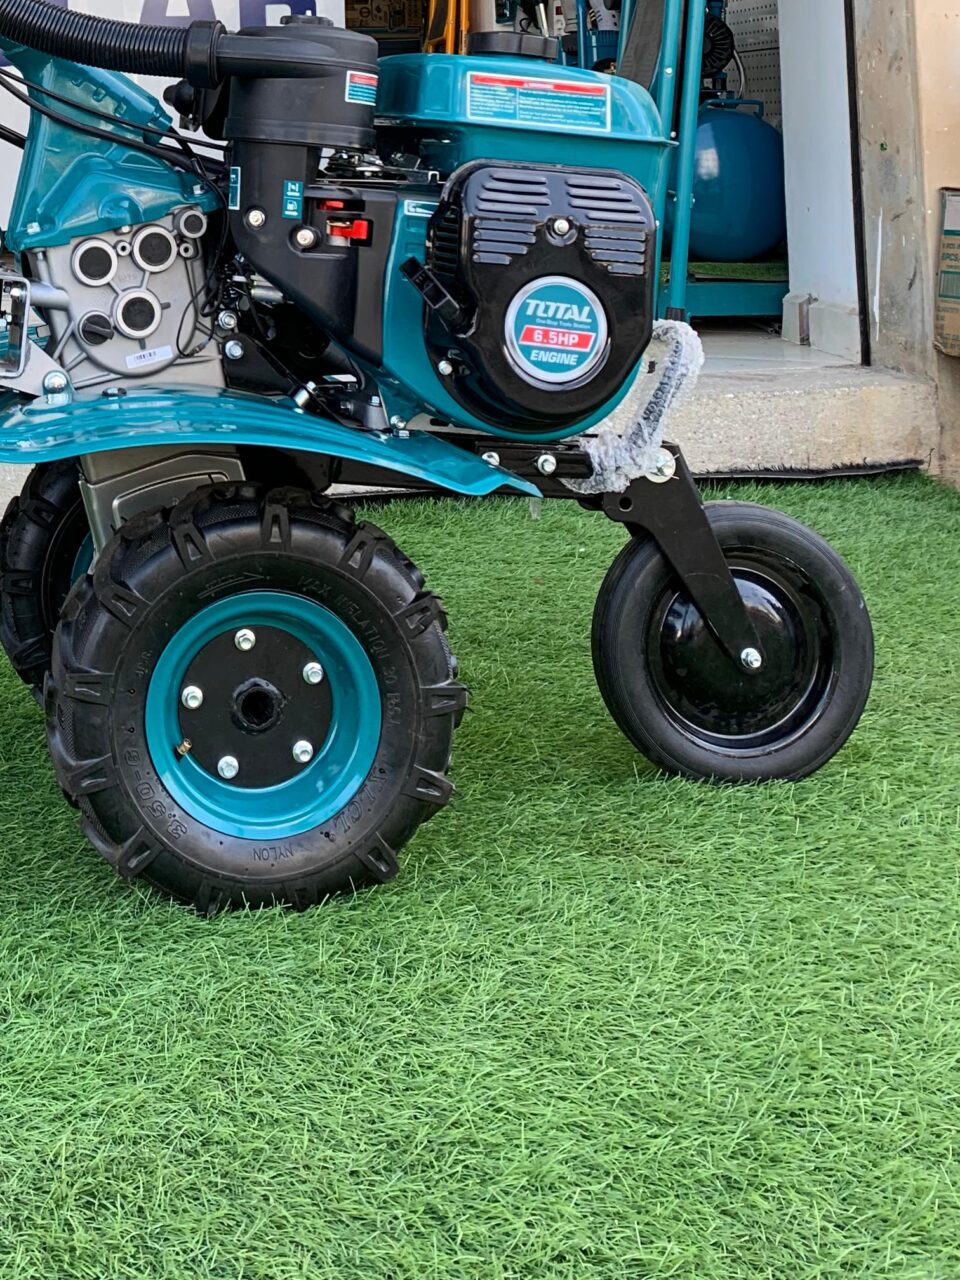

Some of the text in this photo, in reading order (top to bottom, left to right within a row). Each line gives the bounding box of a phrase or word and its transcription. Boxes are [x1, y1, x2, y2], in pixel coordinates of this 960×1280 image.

[525, 299, 592, 323] TOTAL
[533, 329, 579, 347] 6.5HP
[530, 349, 579, 366] ENGINE
[252, 843, 294, 861] NYLON
